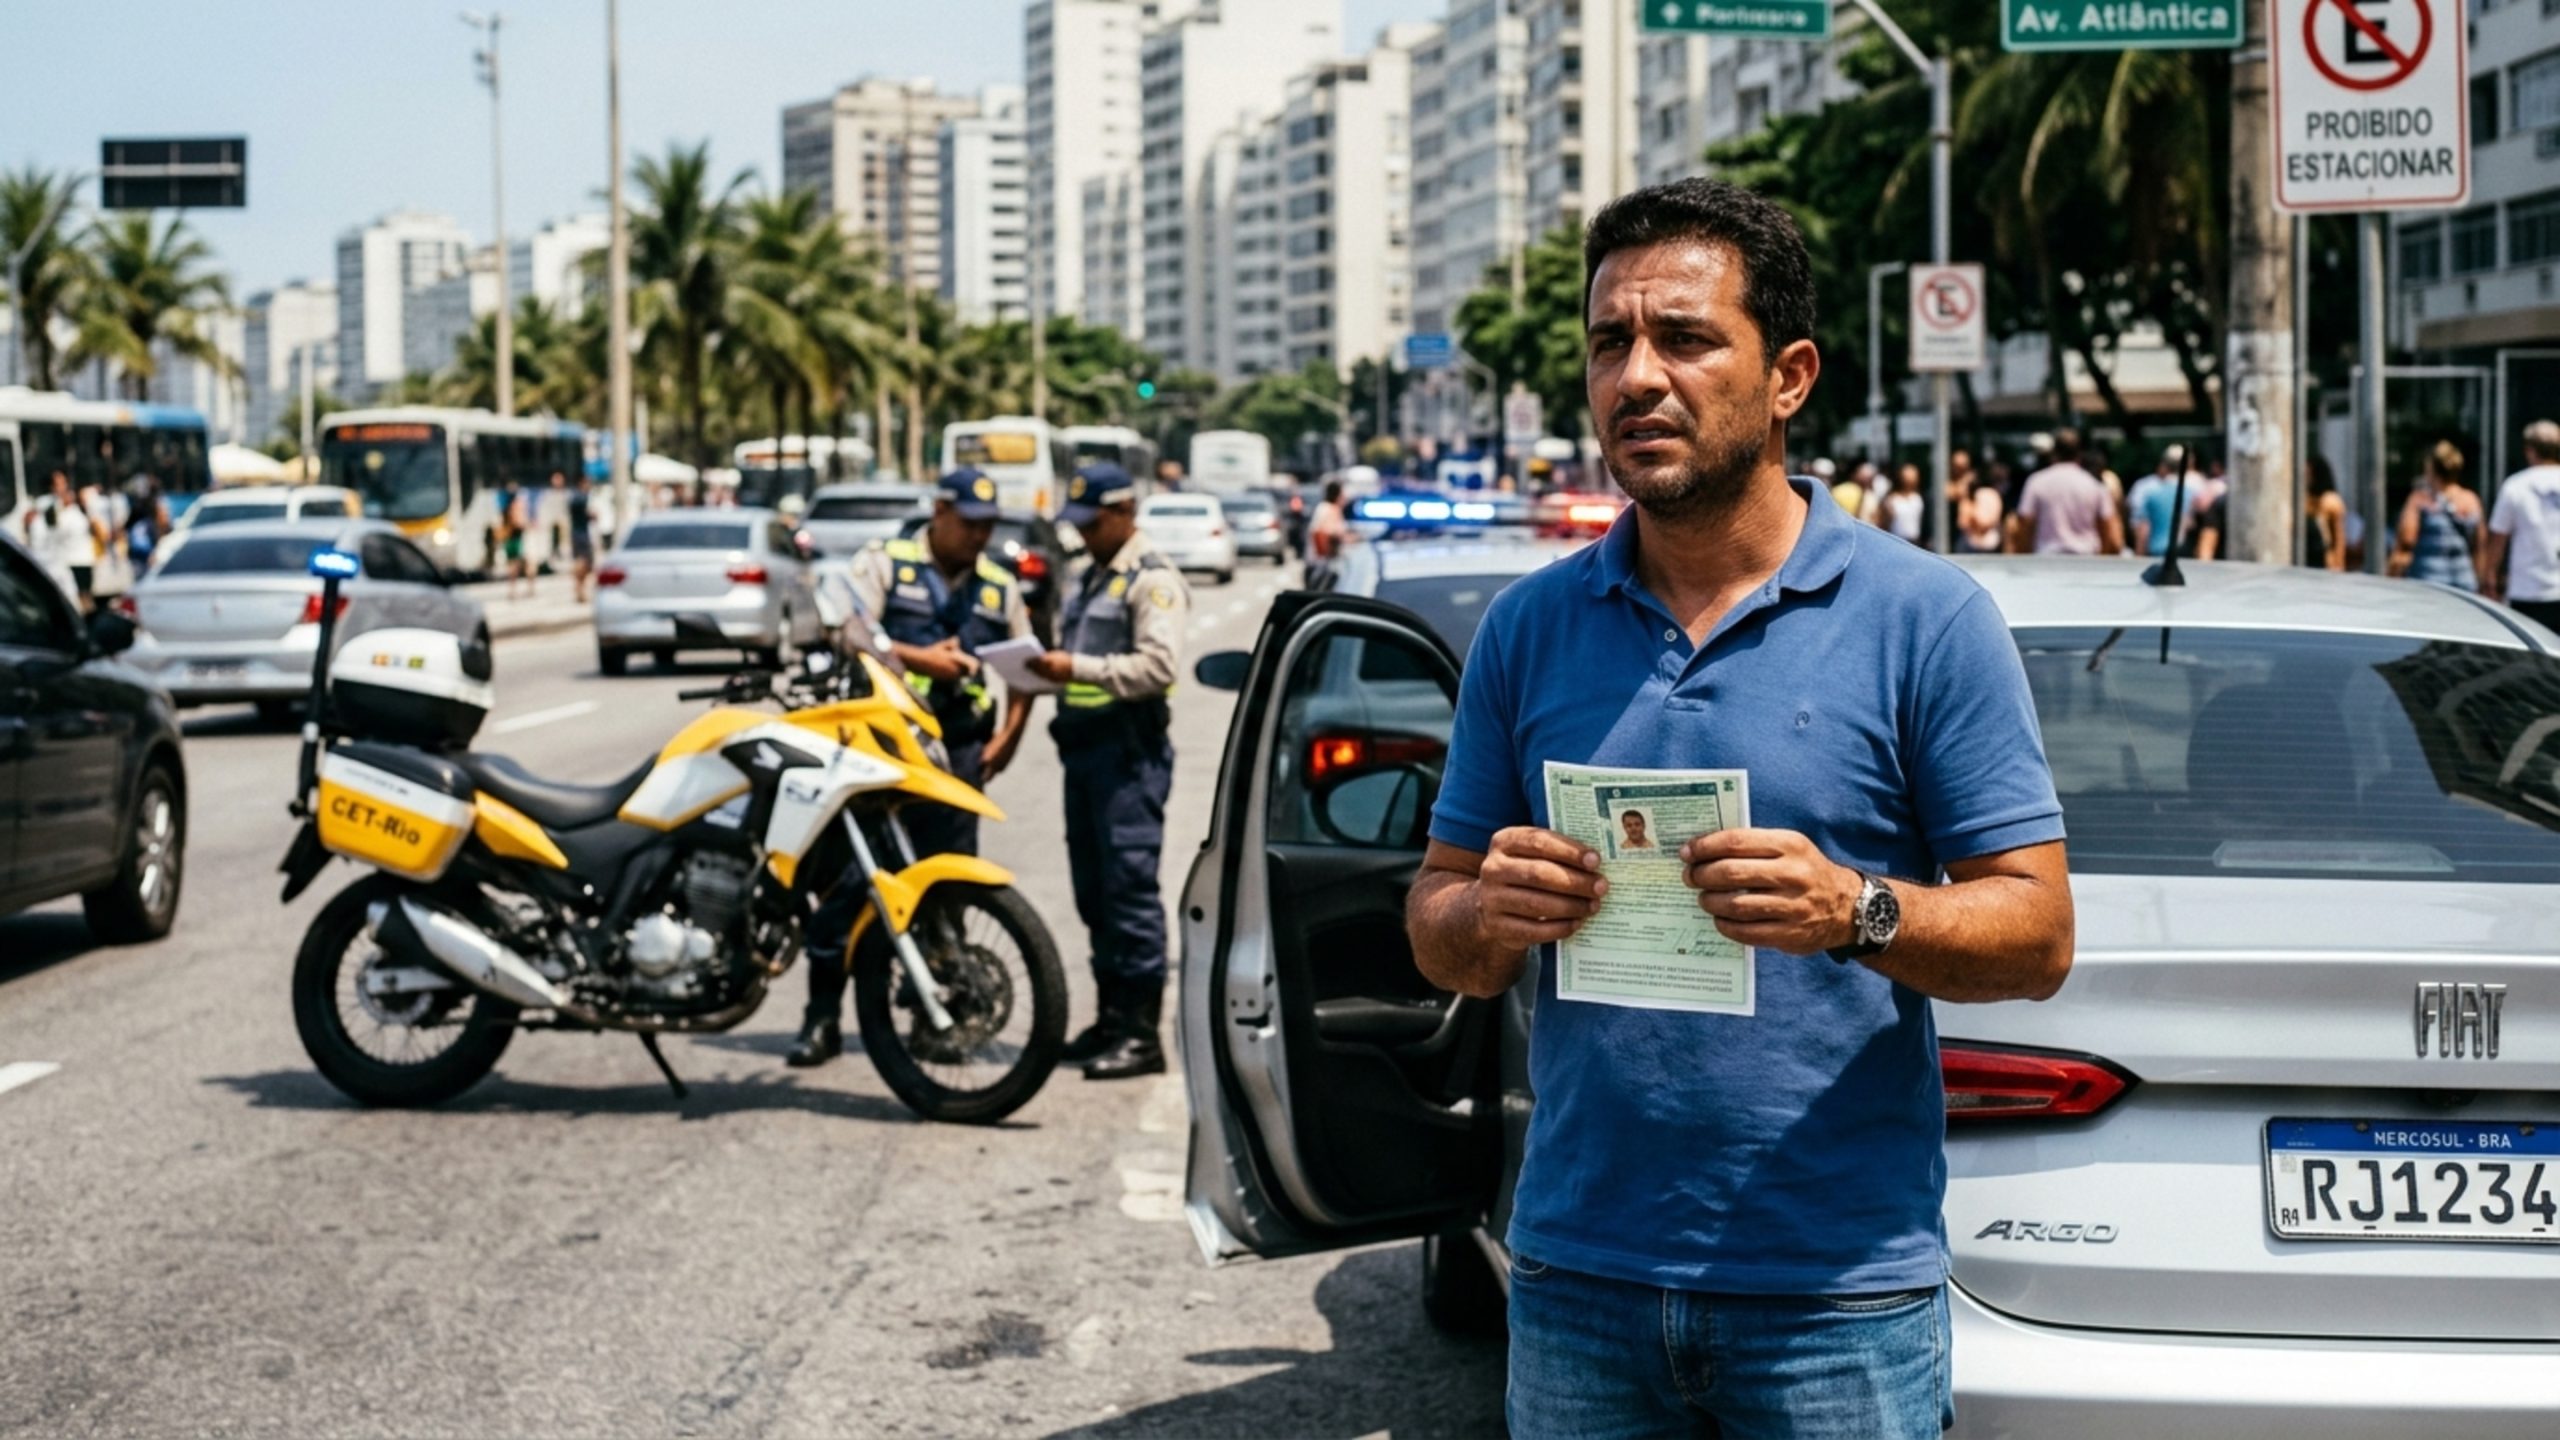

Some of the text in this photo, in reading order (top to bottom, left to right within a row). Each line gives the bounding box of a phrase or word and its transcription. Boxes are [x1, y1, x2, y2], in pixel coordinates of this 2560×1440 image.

[2016, 2, 2230, 33] Av. Atlântica
[2345, 0, 2392, 63] E
[2306, 107, 2433, 140] PROIBIDO
[2287, 147, 2454, 182] ESTACIONAR
[331, 795, 421, 846] CET-Rio
[2415, 982, 2507, 1059] FIAT
[2374, 1131, 2464, 1148] MERCOSUL
[2477, 1132, 2513, 1149] BRA
[2302, 1158, 2557, 1225] RJ1234
[1974, 1219, 2119, 1243] ARGO
